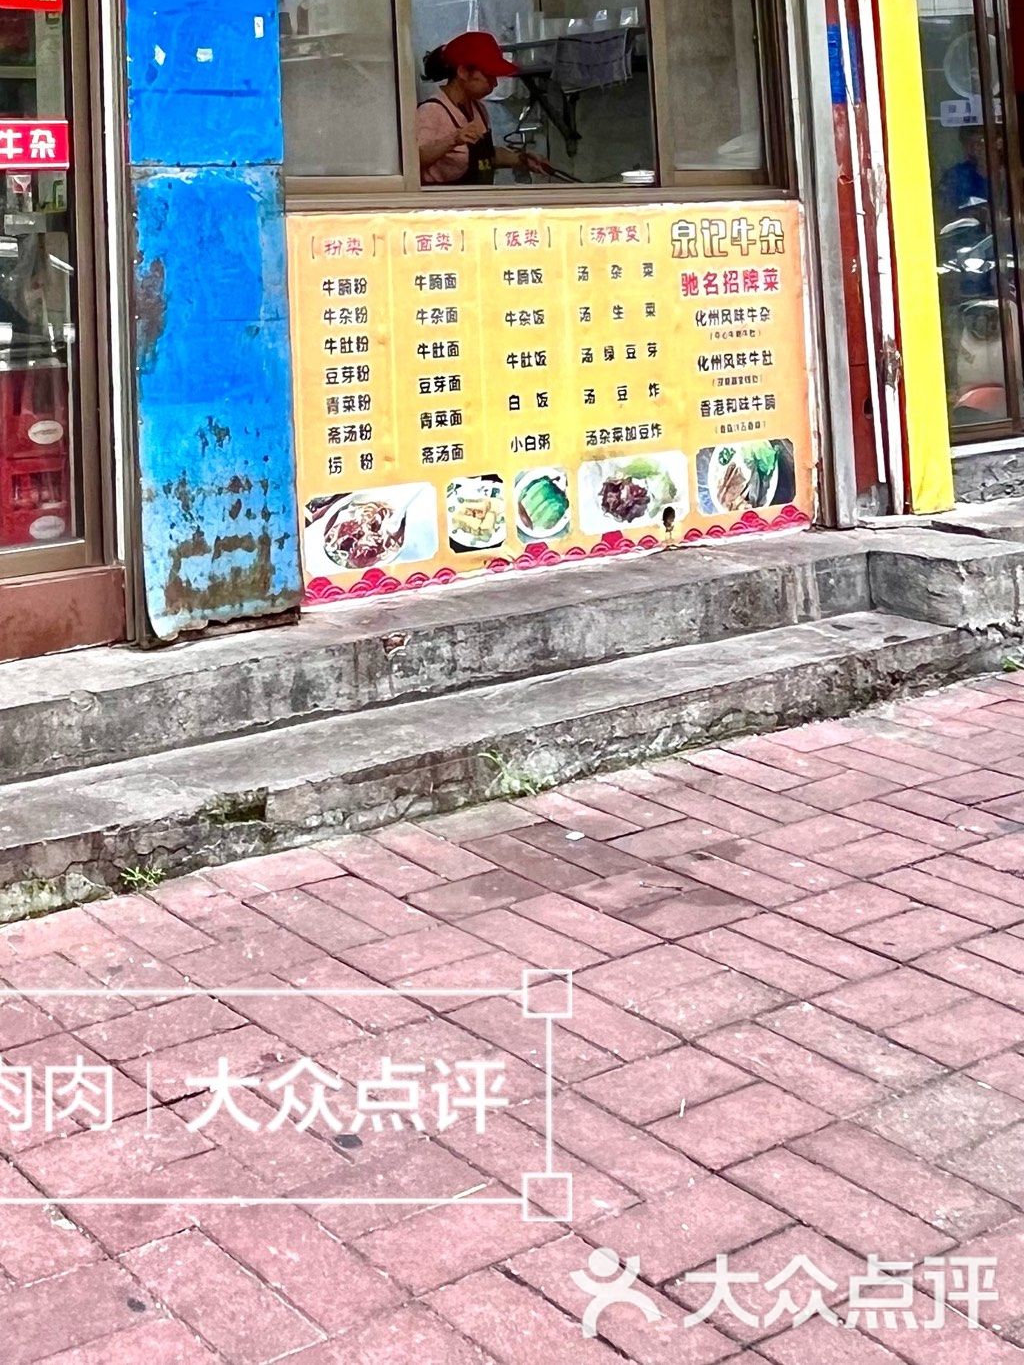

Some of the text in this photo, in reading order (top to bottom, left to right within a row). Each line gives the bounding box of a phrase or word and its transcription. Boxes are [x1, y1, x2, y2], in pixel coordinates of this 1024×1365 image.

[670, 216, 785, 259] 泉记牛杂
[681, 267, 780, 297] 驰名招牌菜
[695, 305, 770, 327] 化州风味牛杂
[324, 336, 369, 354] 牛肚粉
[417, 340, 460, 359] 牛肚面
[506, 351, 547, 369] 牛肚饭
[698, 349, 774, 372] 化州风味牛肚
[325, 365, 370, 384] 豆芽粉
[418, 375, 461, 394] 豆芽面
[510, 433, 551, 453] 小白粥
